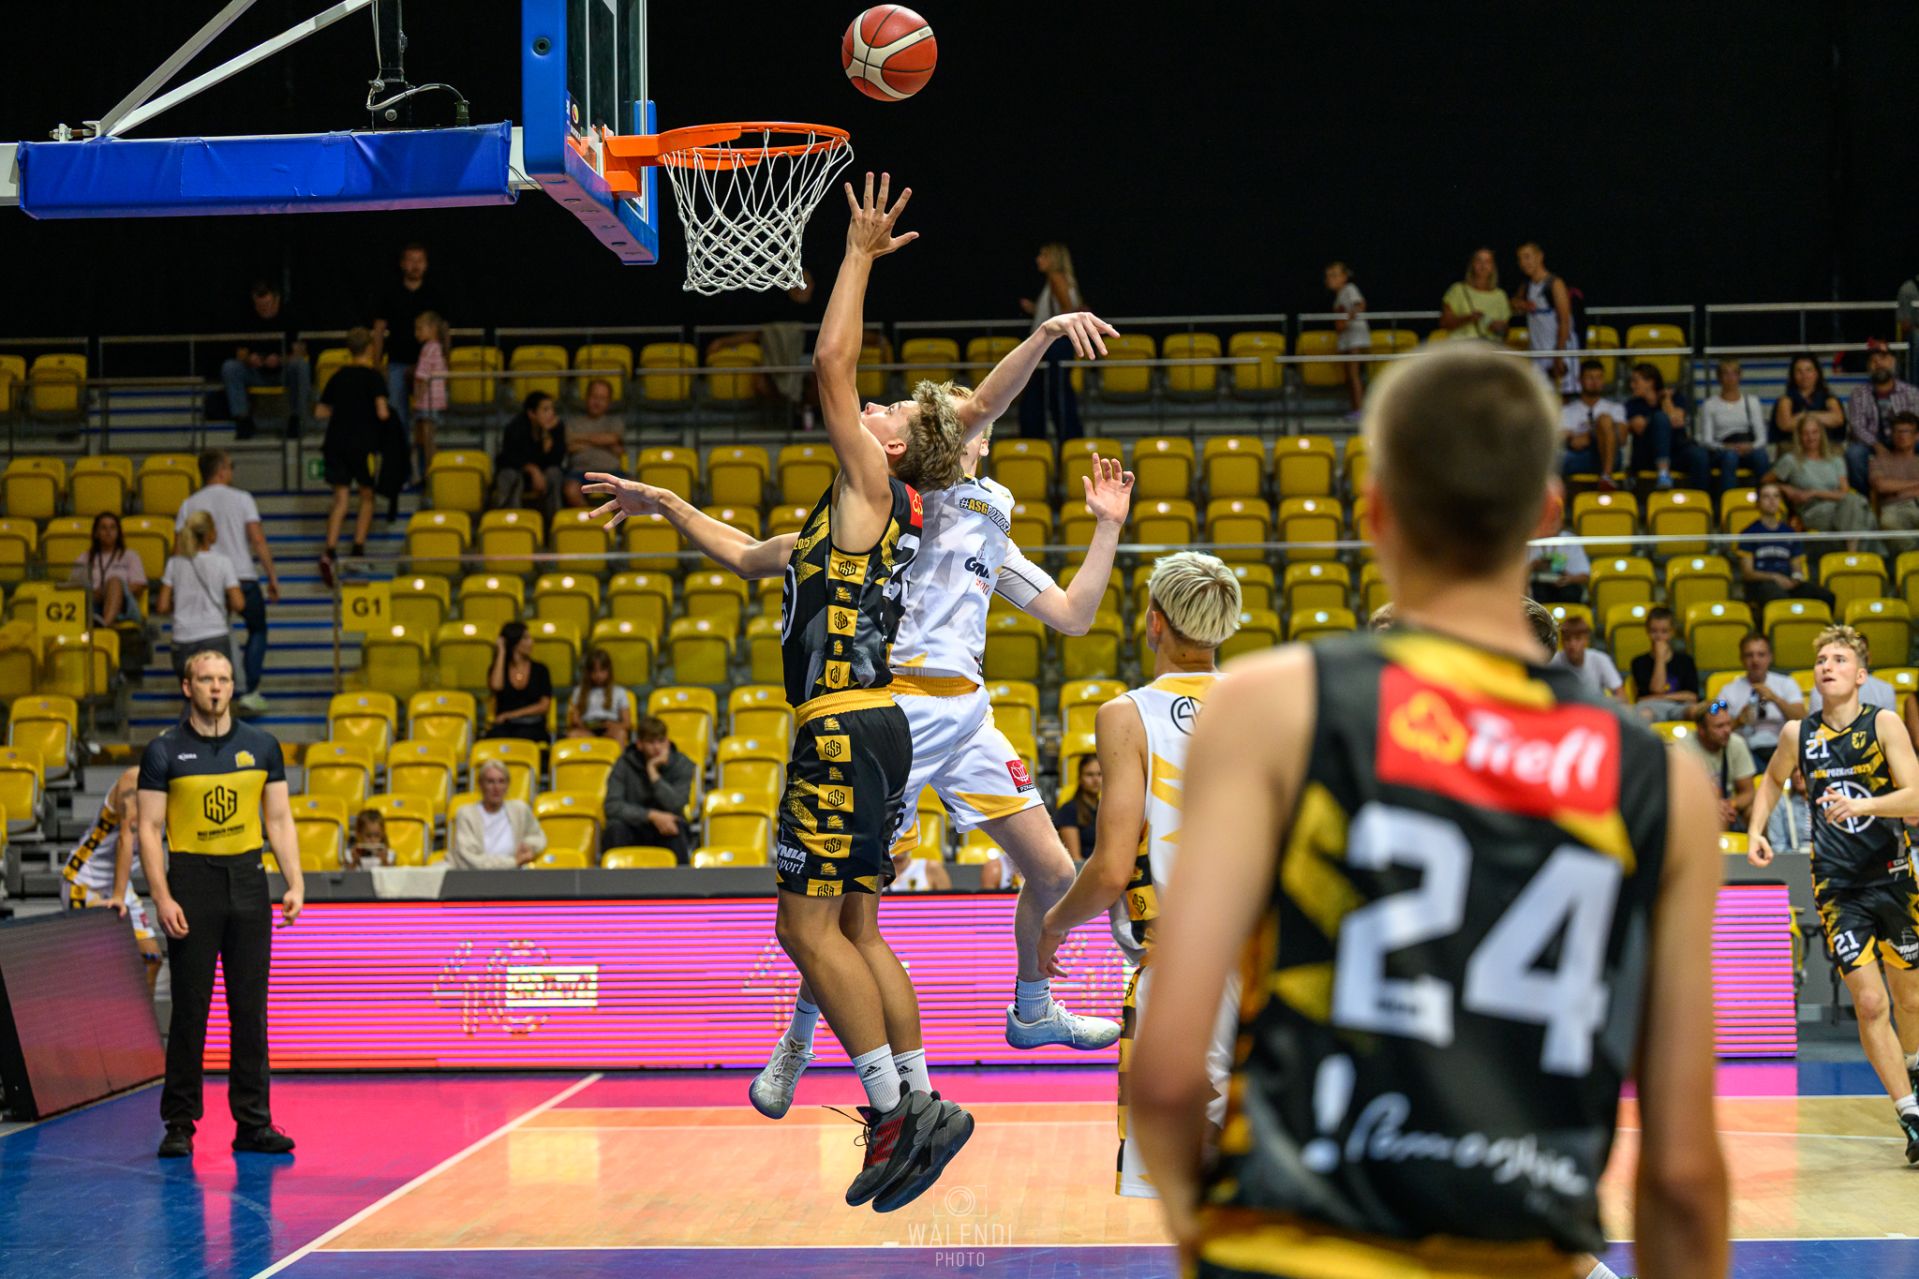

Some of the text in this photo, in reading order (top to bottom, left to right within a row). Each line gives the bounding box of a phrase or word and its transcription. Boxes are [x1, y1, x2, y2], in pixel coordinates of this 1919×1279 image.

[45, 602, 77, 622] G2
[352, 597, 382, 617] G1
[1805, 738, 1830, 760] 21
[203, 785, 238, 825] ASG
[1331, 800, 1623, 1076] 24
[1833, 929, 1861, 956] 21
